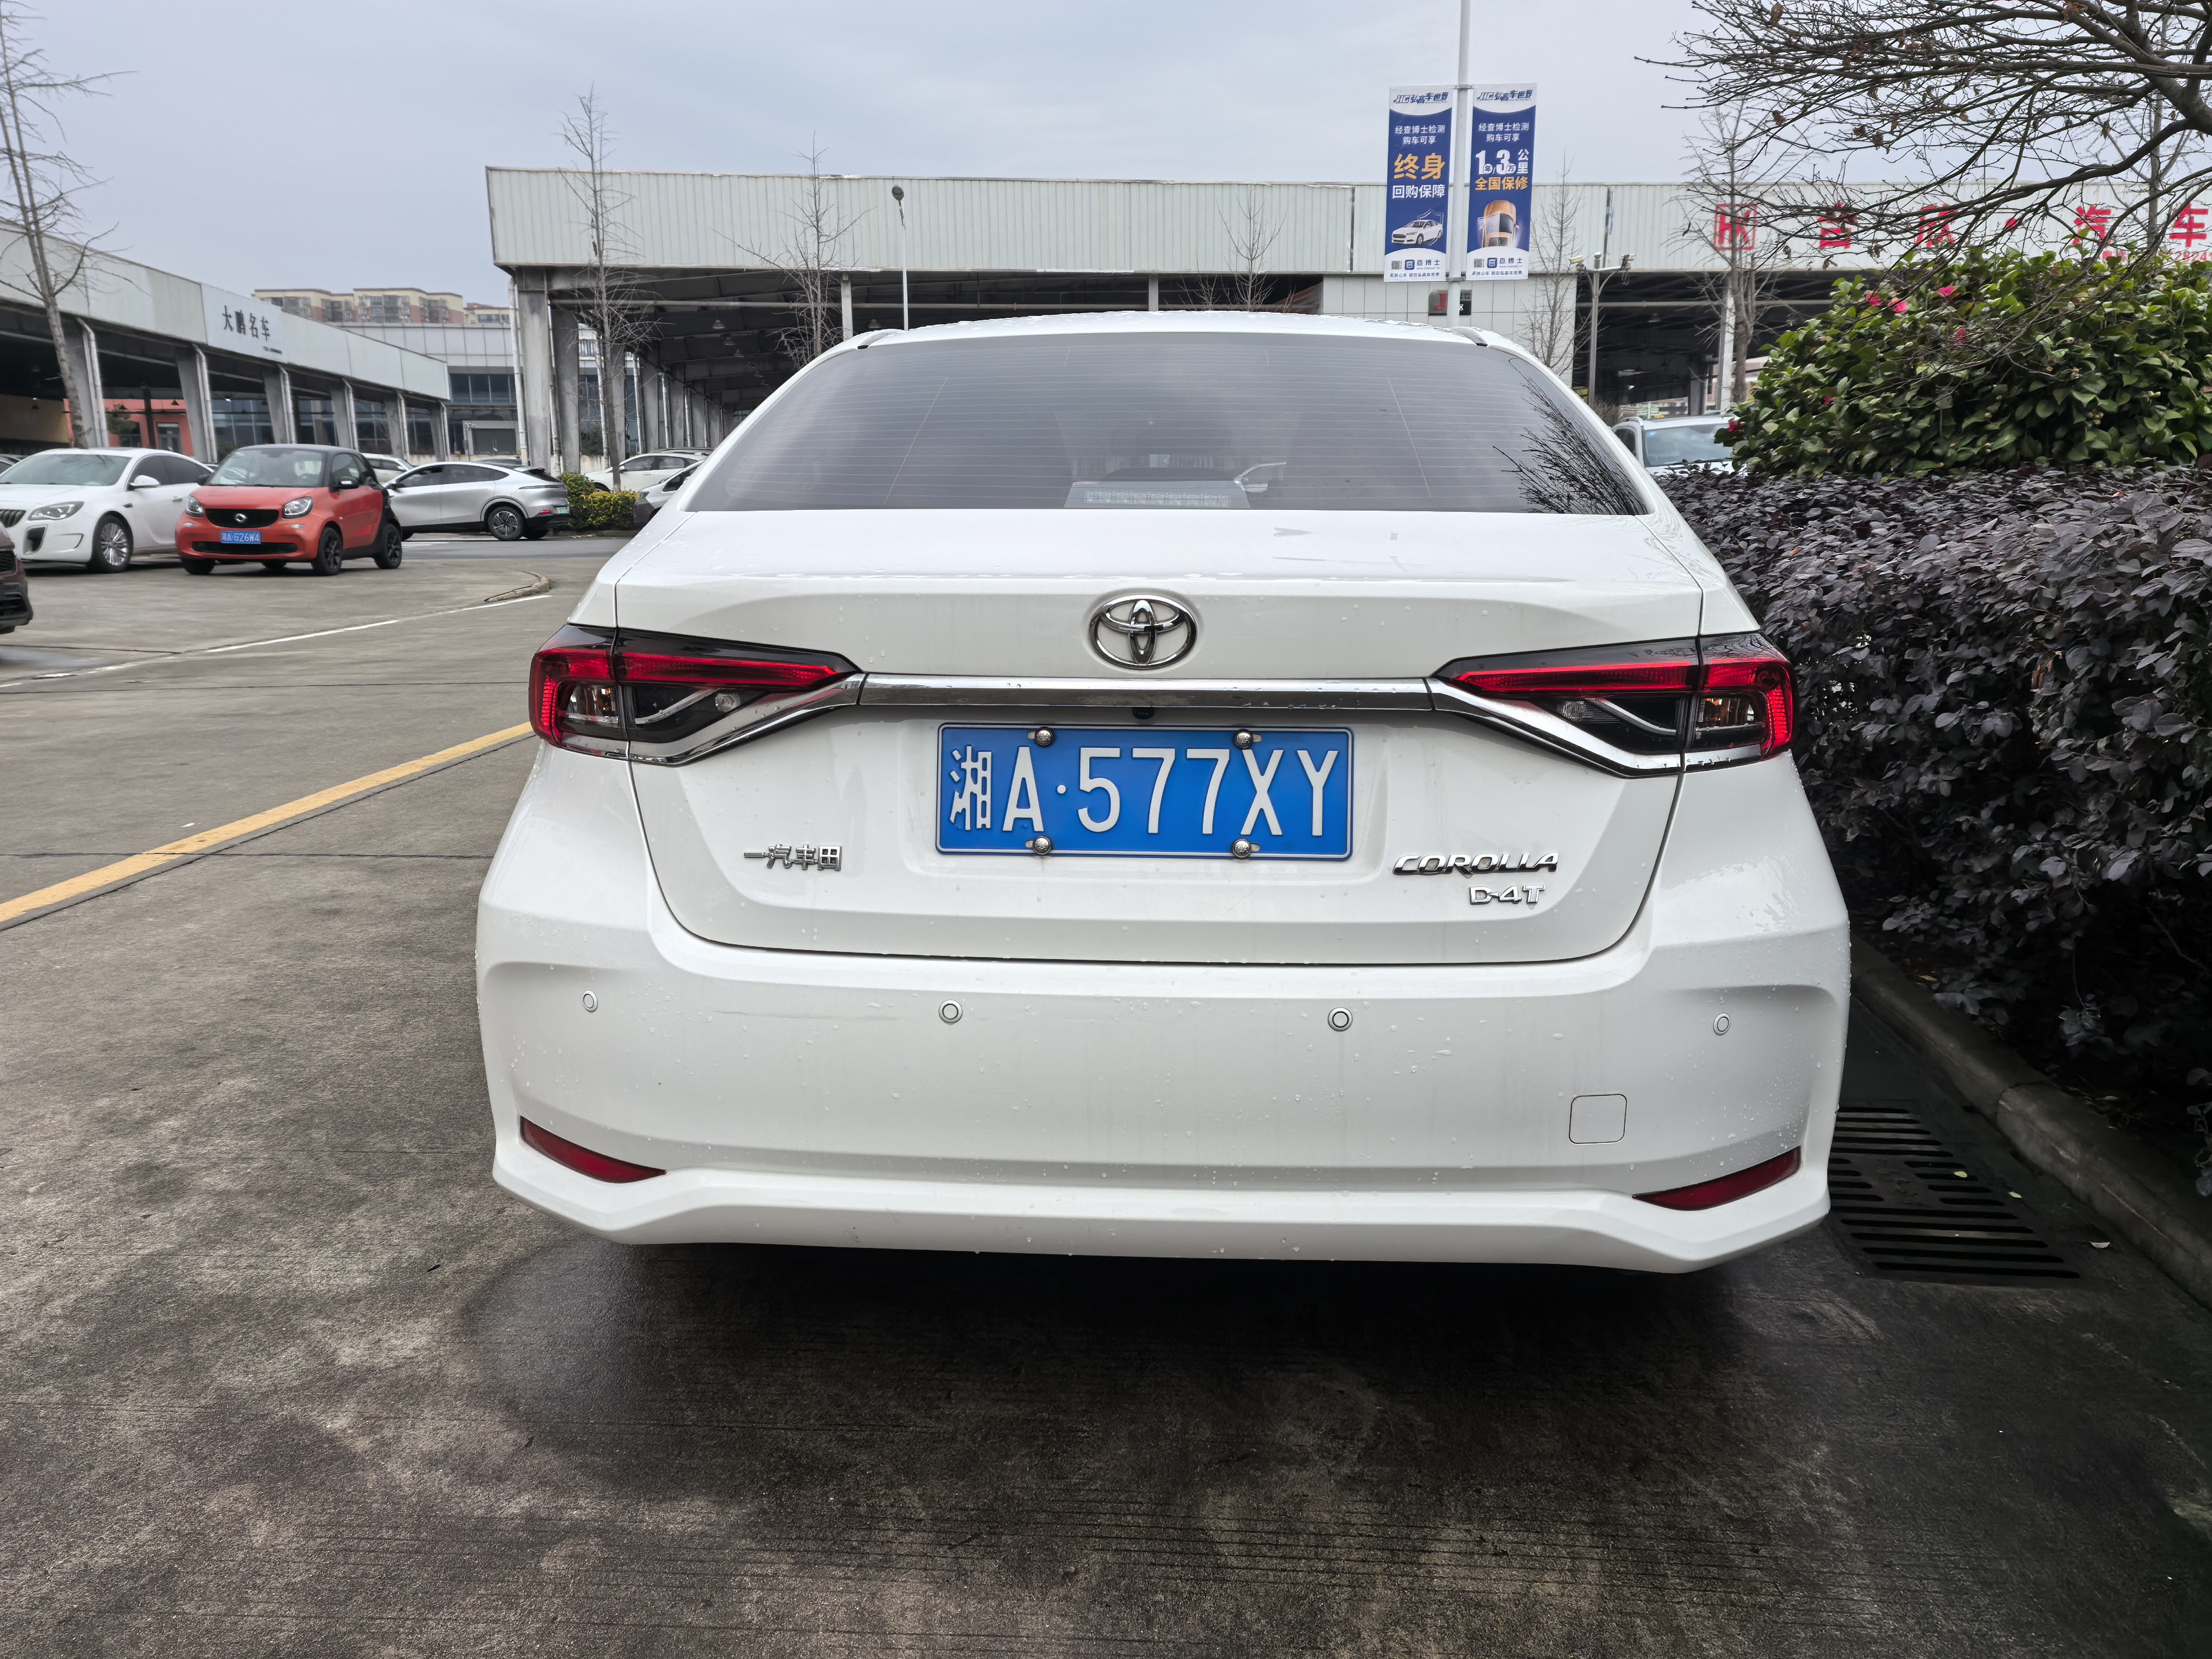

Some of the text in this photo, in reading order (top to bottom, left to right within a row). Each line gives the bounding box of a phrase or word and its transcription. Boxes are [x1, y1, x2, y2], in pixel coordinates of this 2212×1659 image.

[1395, 125, 1446, 134] 经查博士检测
[1479, 122, 1529, 132] 经查博士检测
[1403, 136, 1437, 145] 购车可享
[1486, 133, 1520, 142] 购车可享
[1394, 152, 1446, 180] 终身
[1475, 176, 1528, 190] 全国保修
[1393, 184, 1446, 199] 回购保障
[744, 844, 842, 871] 一汽丰田
[1392, 852, 1559, 875] COROLLA
[1469, 885, 1546, 905] D-4T
